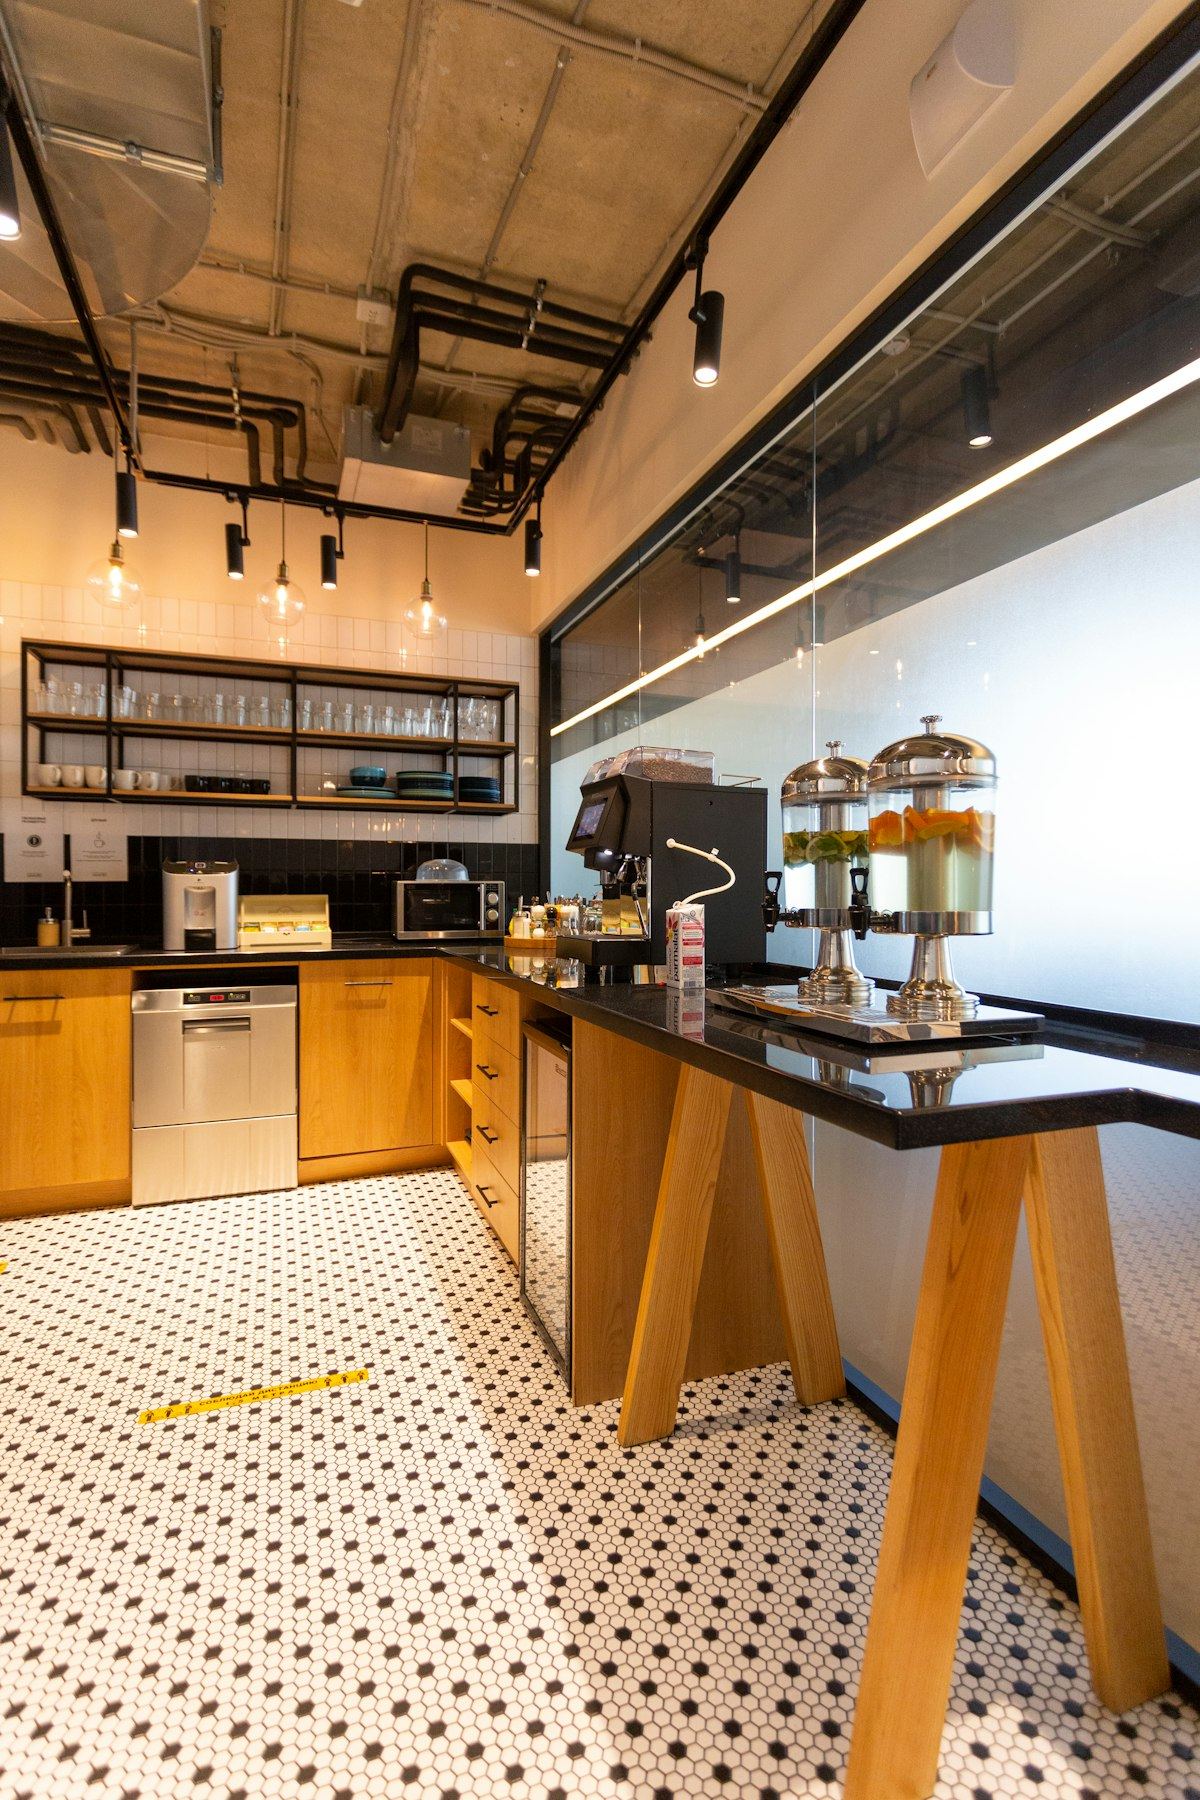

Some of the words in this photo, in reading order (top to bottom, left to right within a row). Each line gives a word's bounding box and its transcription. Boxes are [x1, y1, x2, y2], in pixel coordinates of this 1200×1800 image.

[672, 929, 680, 982] parmalat
[252, 1390, 294, 1400] МЕТРА
[258, 1380, 318, 1395] ДИСТАНЦИЮ
